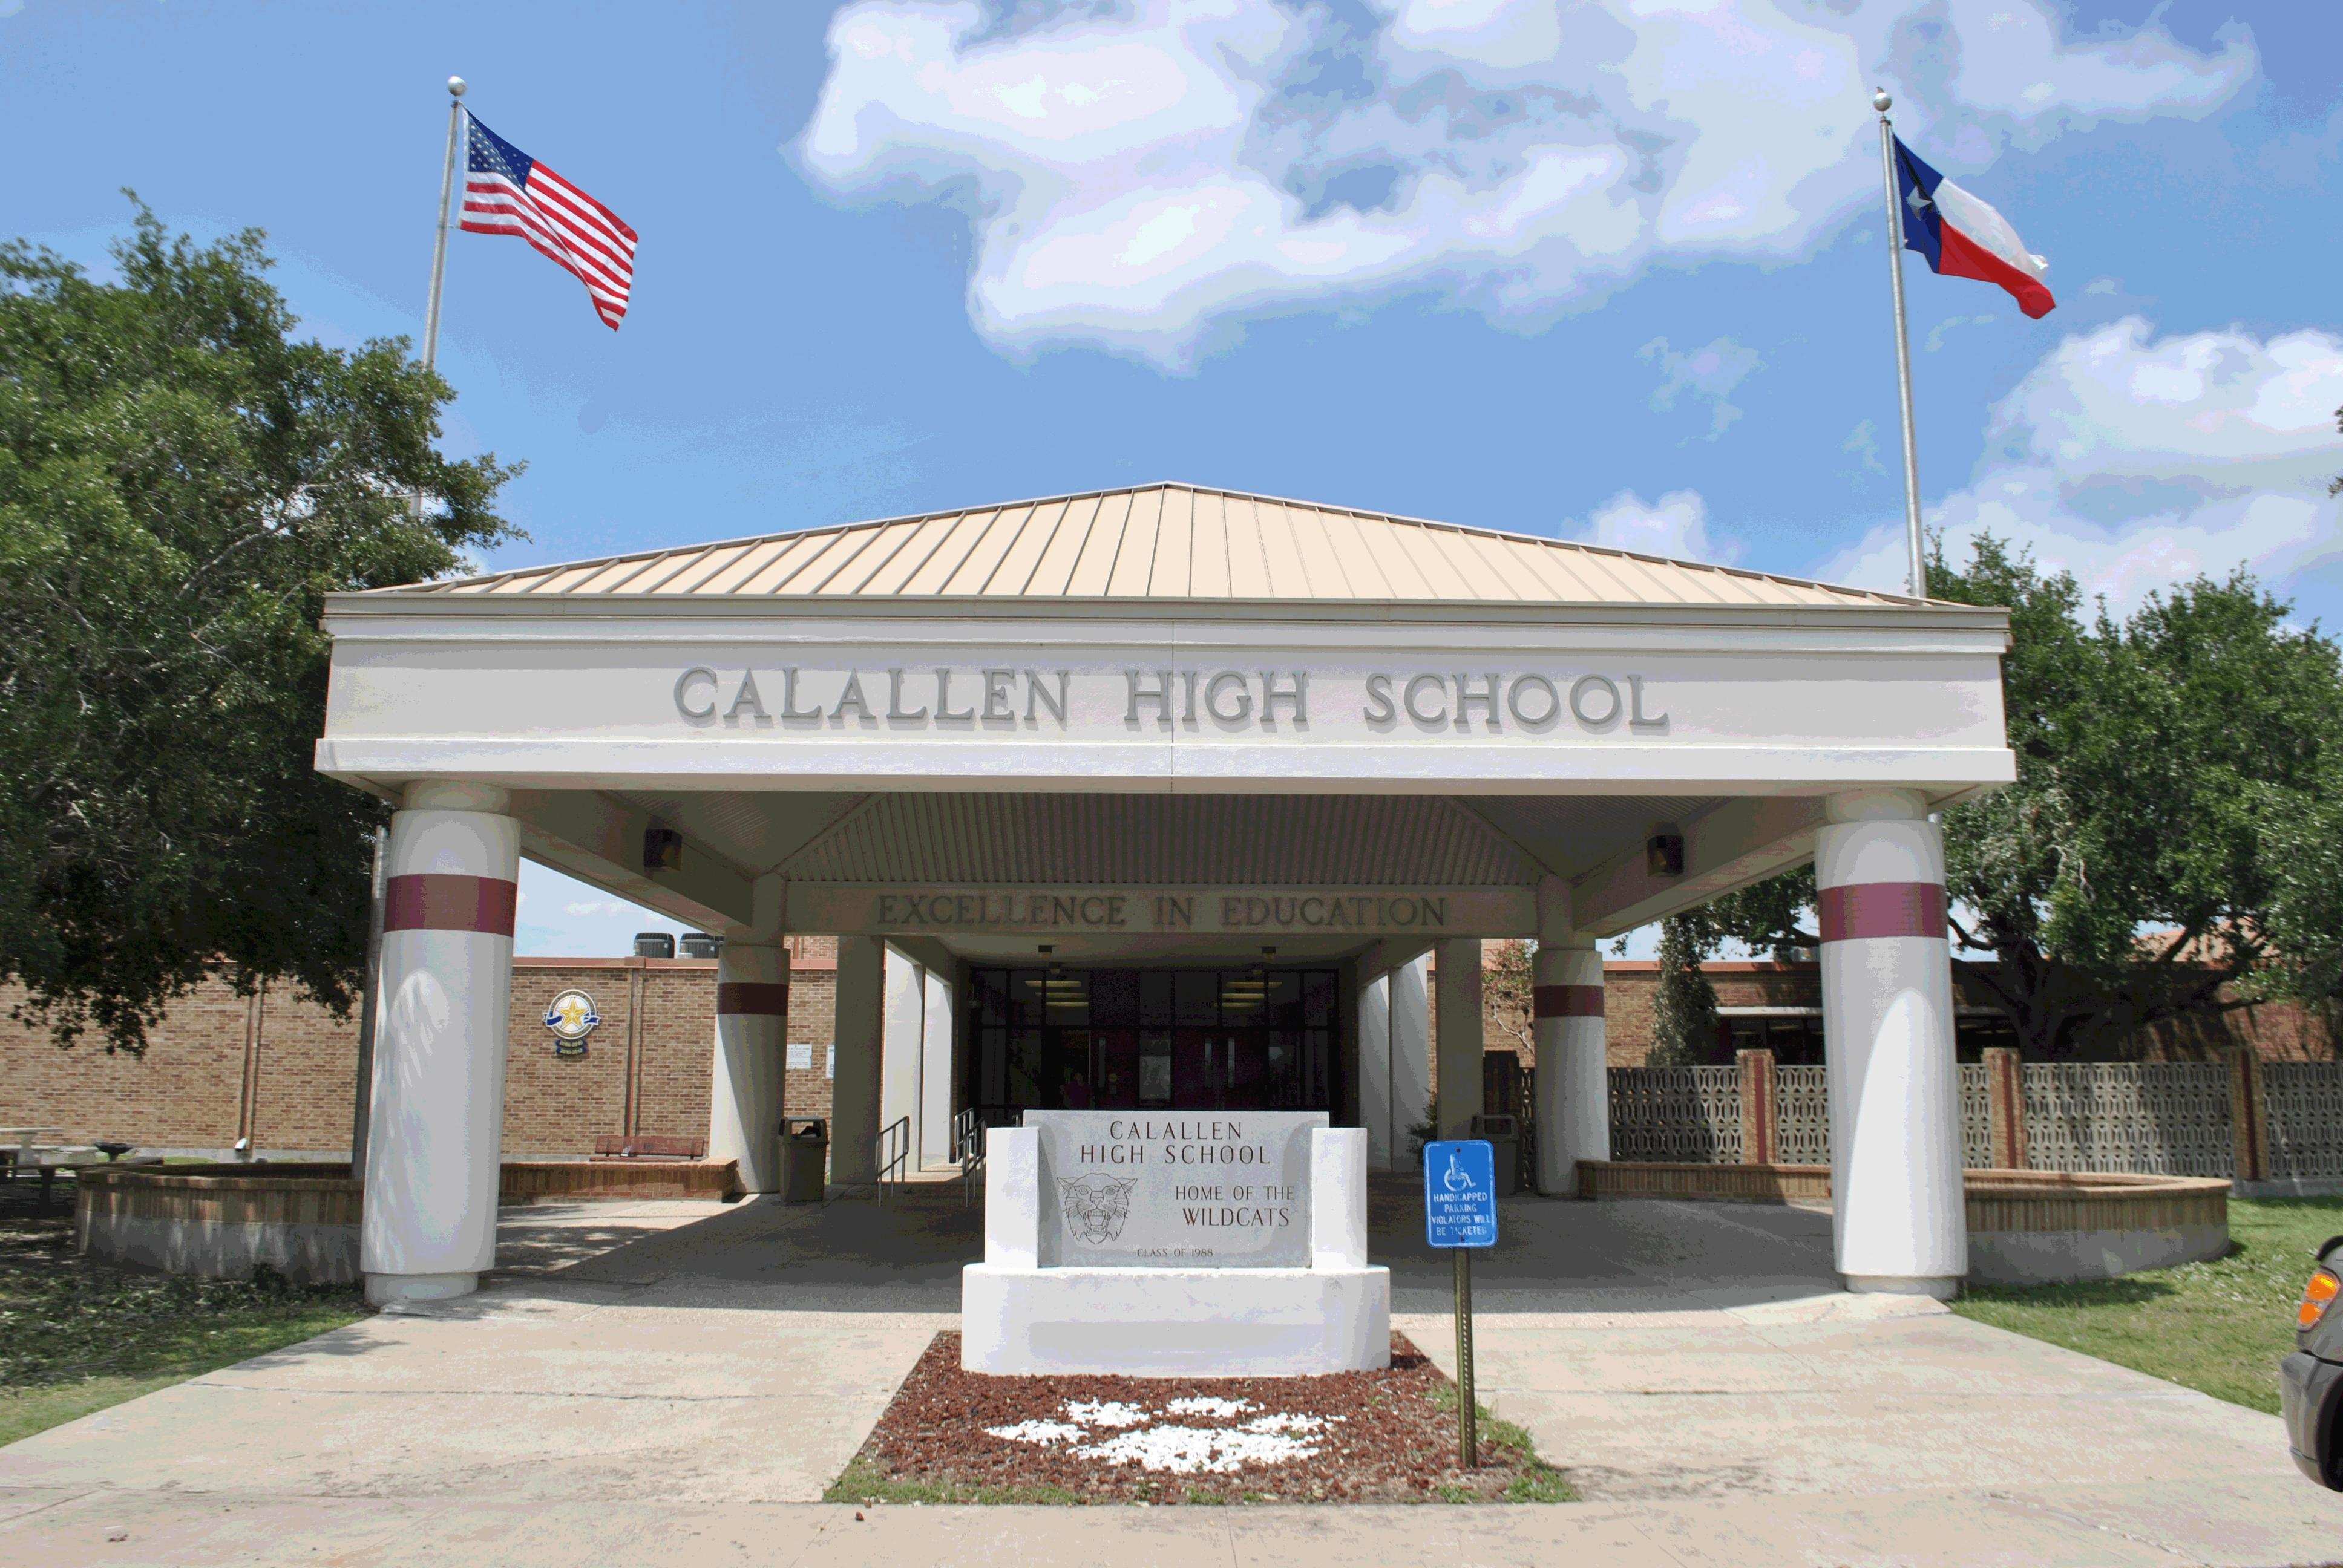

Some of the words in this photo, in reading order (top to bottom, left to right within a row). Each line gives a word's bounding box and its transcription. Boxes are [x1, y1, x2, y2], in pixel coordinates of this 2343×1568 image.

[673, 667, 1069, 720] CALALLEN
[1123, 669, 1308, 724] HIGH
[1362, 672, 1669, 727] SCHOOL
[877, 895, 1127, 925] EXCELLENCE
[1155, 896, 1194, 926] IN
[1221, 897, 1445, 926] EDUCATION
[1110, 1120, 1242, 1140] CALALLEN
[1081, 1145, 1144, 1164] HIGH
[1165, 1145, 1271, 1164] SCHOOL
[1176, 1186, 1223, 1200] HOME
[1233, 1186, 1254, 1200] OF
[1263, 1186, 1295, 1200] THE
[1433, 1192, 1487, 1203] HANDICAPPED
[1444, 1204, 1477, 1213] PARKING
[1182, 1207, 1289, 1227] WILDCATS
[1430, 1215, 1472, 1224] VIOLATORS
[1473, 1214, 1491, 1224] WILL
[1436, 1226, 1447, 1236] BE
[1137, 1248, 1168, 1258] CLASS
[1173, 1248, 1186, 1258] OF
[1191, 1247, 1214, 1258] 1988
